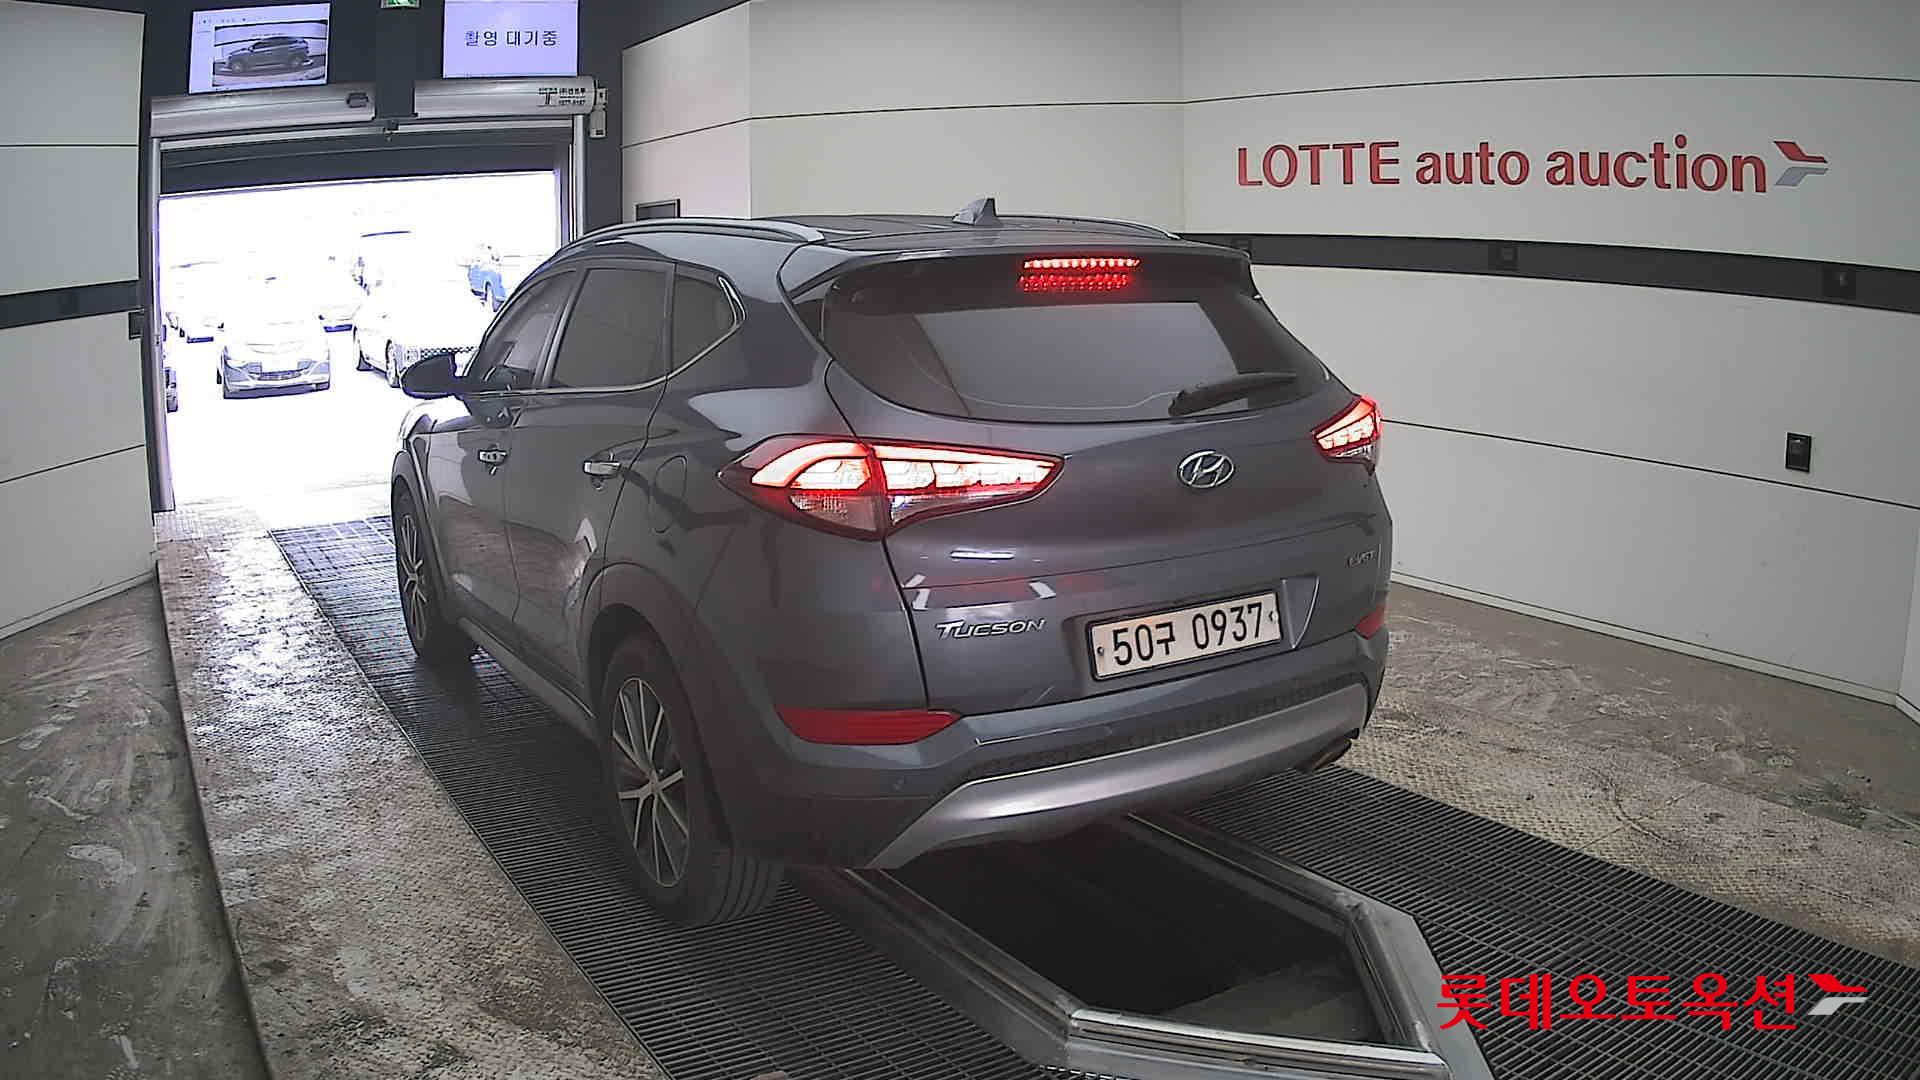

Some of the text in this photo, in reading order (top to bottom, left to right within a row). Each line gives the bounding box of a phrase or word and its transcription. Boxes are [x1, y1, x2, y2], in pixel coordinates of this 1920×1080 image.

[465, 30, 557, 47] 촬영 대기중
[1238, 134, 1767, 193] LOTTE auto auction
[936, 618, 1045, 639] TUCSON
[1112, 602, 1263, 666] 50구 0937
